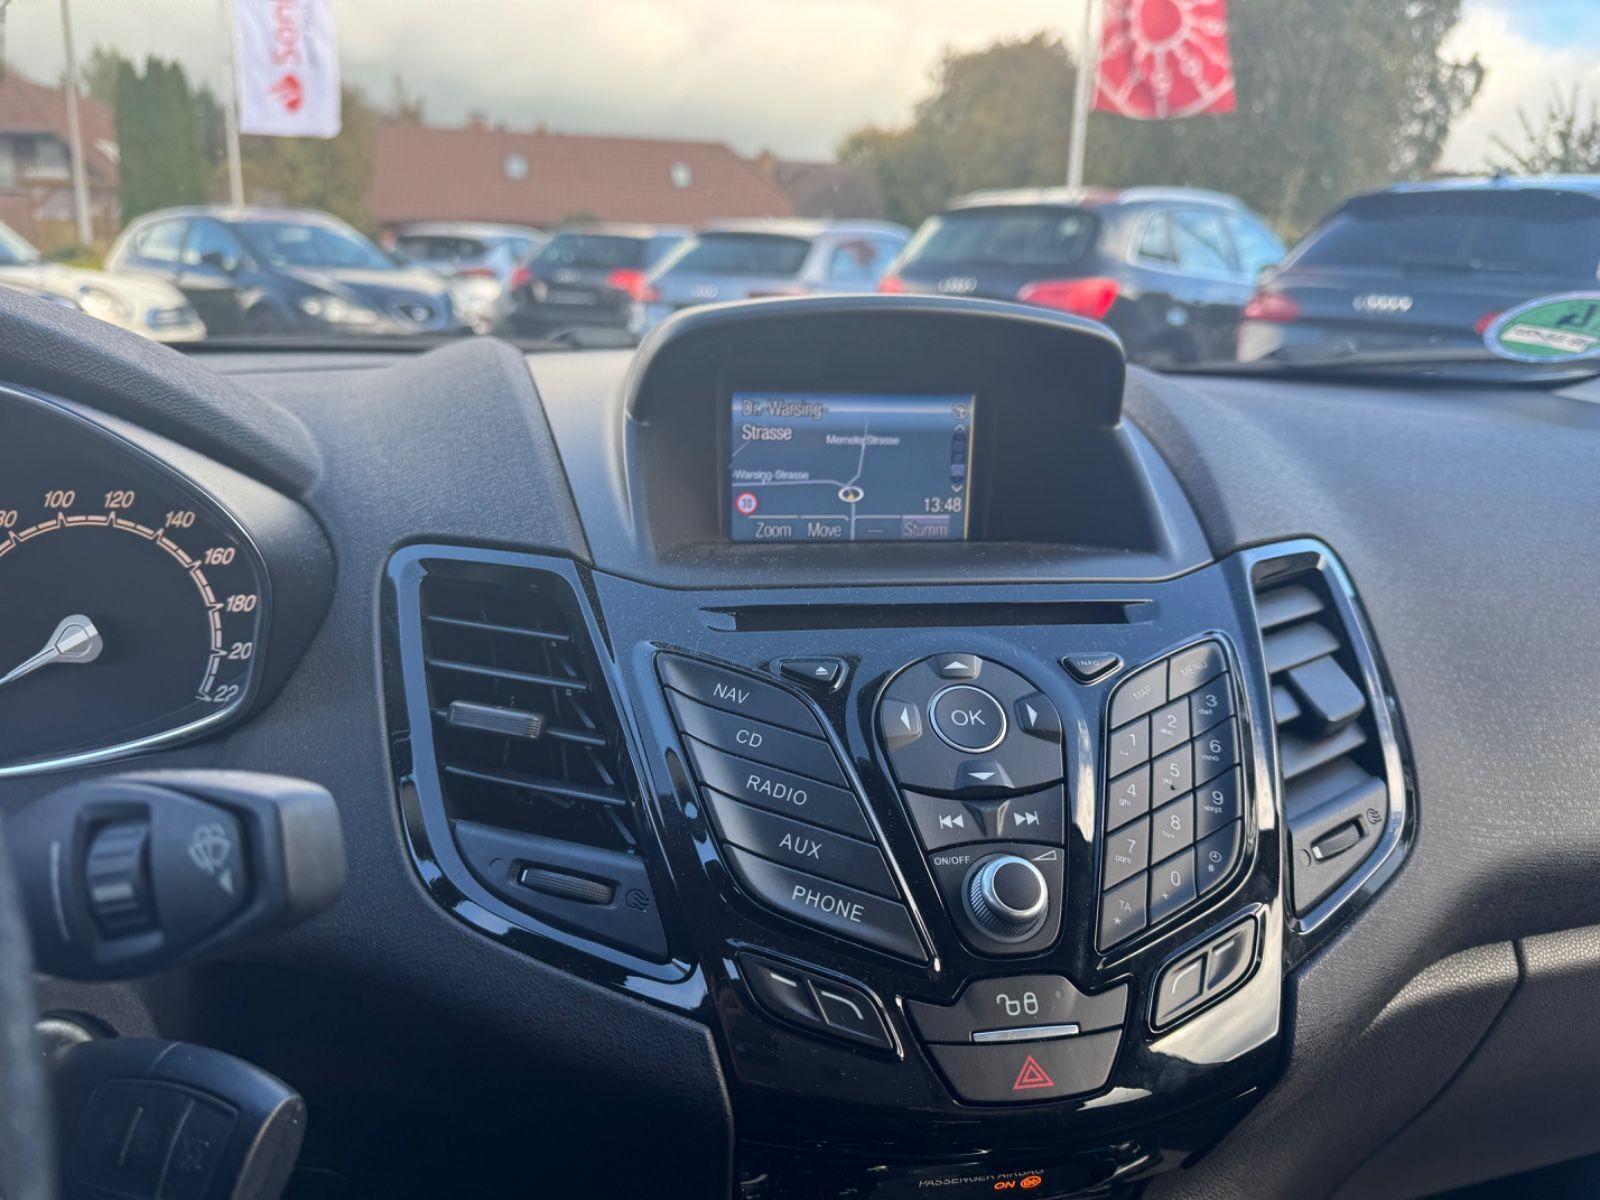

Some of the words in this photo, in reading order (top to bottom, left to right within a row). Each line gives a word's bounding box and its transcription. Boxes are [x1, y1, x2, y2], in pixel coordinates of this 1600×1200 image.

[742, 424, 792, 440] Strasse
[44, 490, 75, 508] 100
[104, 490, 135, 508] 120
[923, 497, 963, 513] 13:48
[165, 511, 195, 528] 140
[755, 522, 792, 538] Zoom
[807, 522, 842, 537] Move
[204, 547, 235, 565] 160
[226, 594, 257, 612] 180
[713, 682, 750, 705] NAV
[1205, 694, 1218, 707] 3
[951, 709, 986, 727] OK
[1167, 714, 1178, 729] 2
[735, 729, 763, 748] CD
[1129, 733, 1137, 748] 1
[1209, 739, 1221, 754] 6
[1169, 763, 1180, 778] 5
[746, 774, 808, 806] RADIO
[1126, 783, 1137, 798] 4
[1212, 790, 1224, 806] 9
[1170, 815, 1181, 830] 8
[779, 833, 823, 860] AUX
[1126, 838, 1137, 854] 7
[933, 855, 970, 866] ON/OFF
[1170, 870, 1181, 887] 0
[792, 885, 864, 922] PHONE
[994, 1181, 1016, 1190] ON
